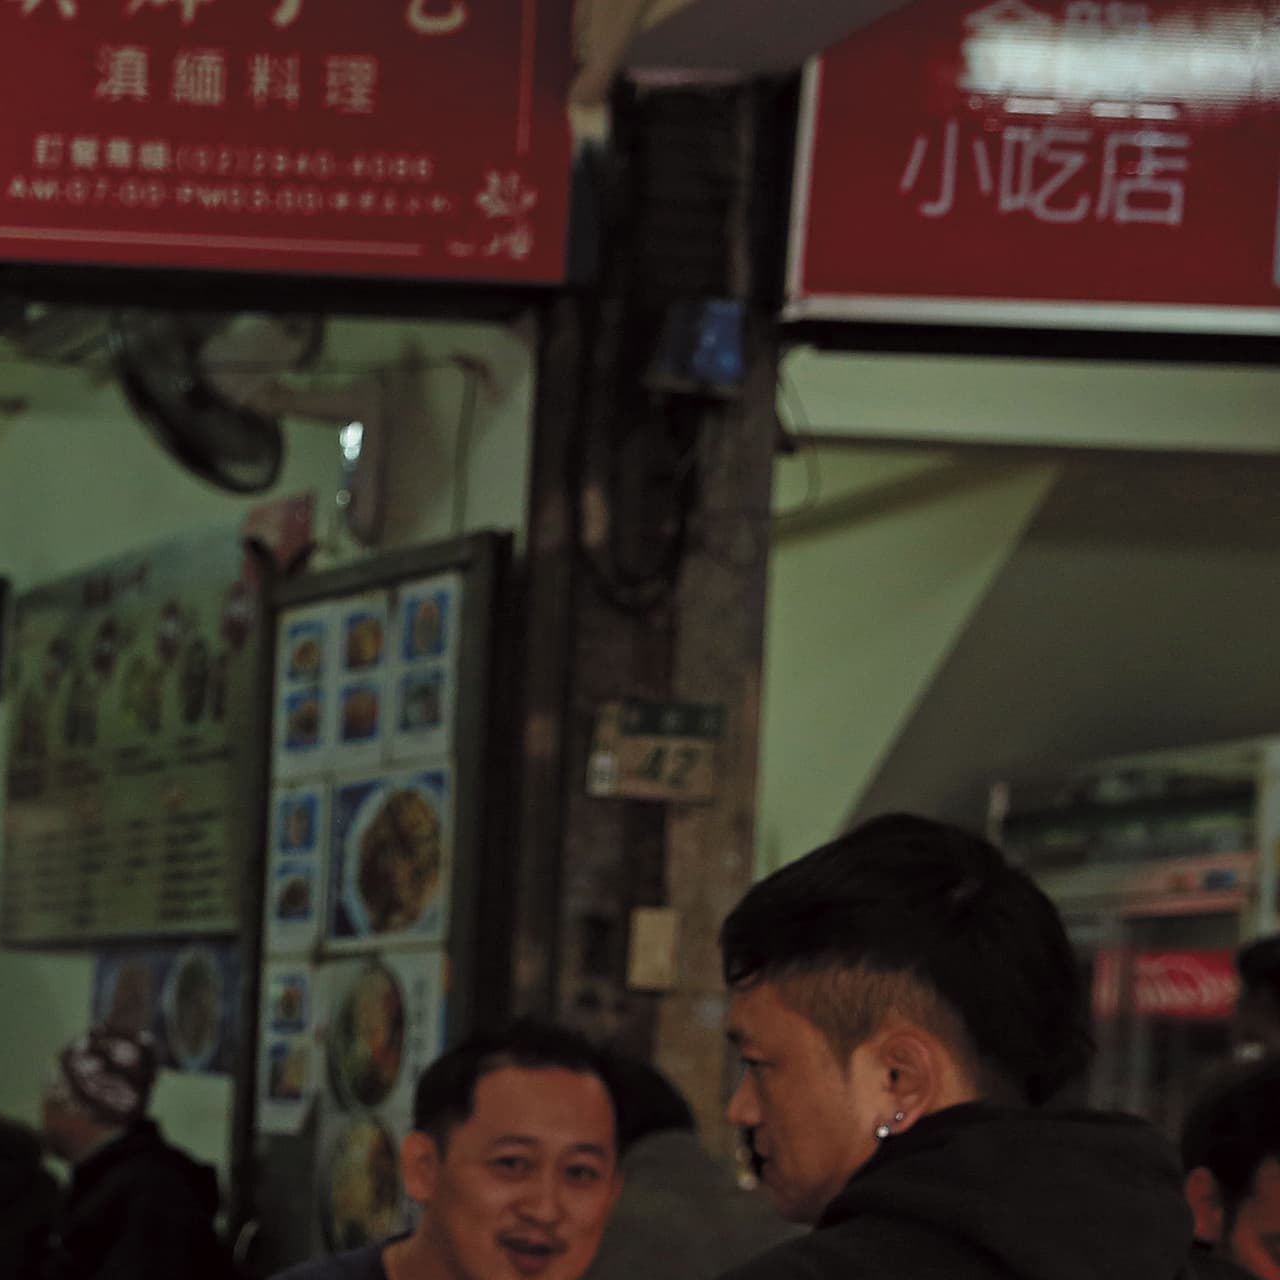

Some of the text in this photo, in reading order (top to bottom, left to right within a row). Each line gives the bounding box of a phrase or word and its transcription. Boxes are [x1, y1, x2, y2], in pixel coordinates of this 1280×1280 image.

[94, 44, 380, 115] 滇緬料理
[898, 118, 1193, 227] 小吃店
